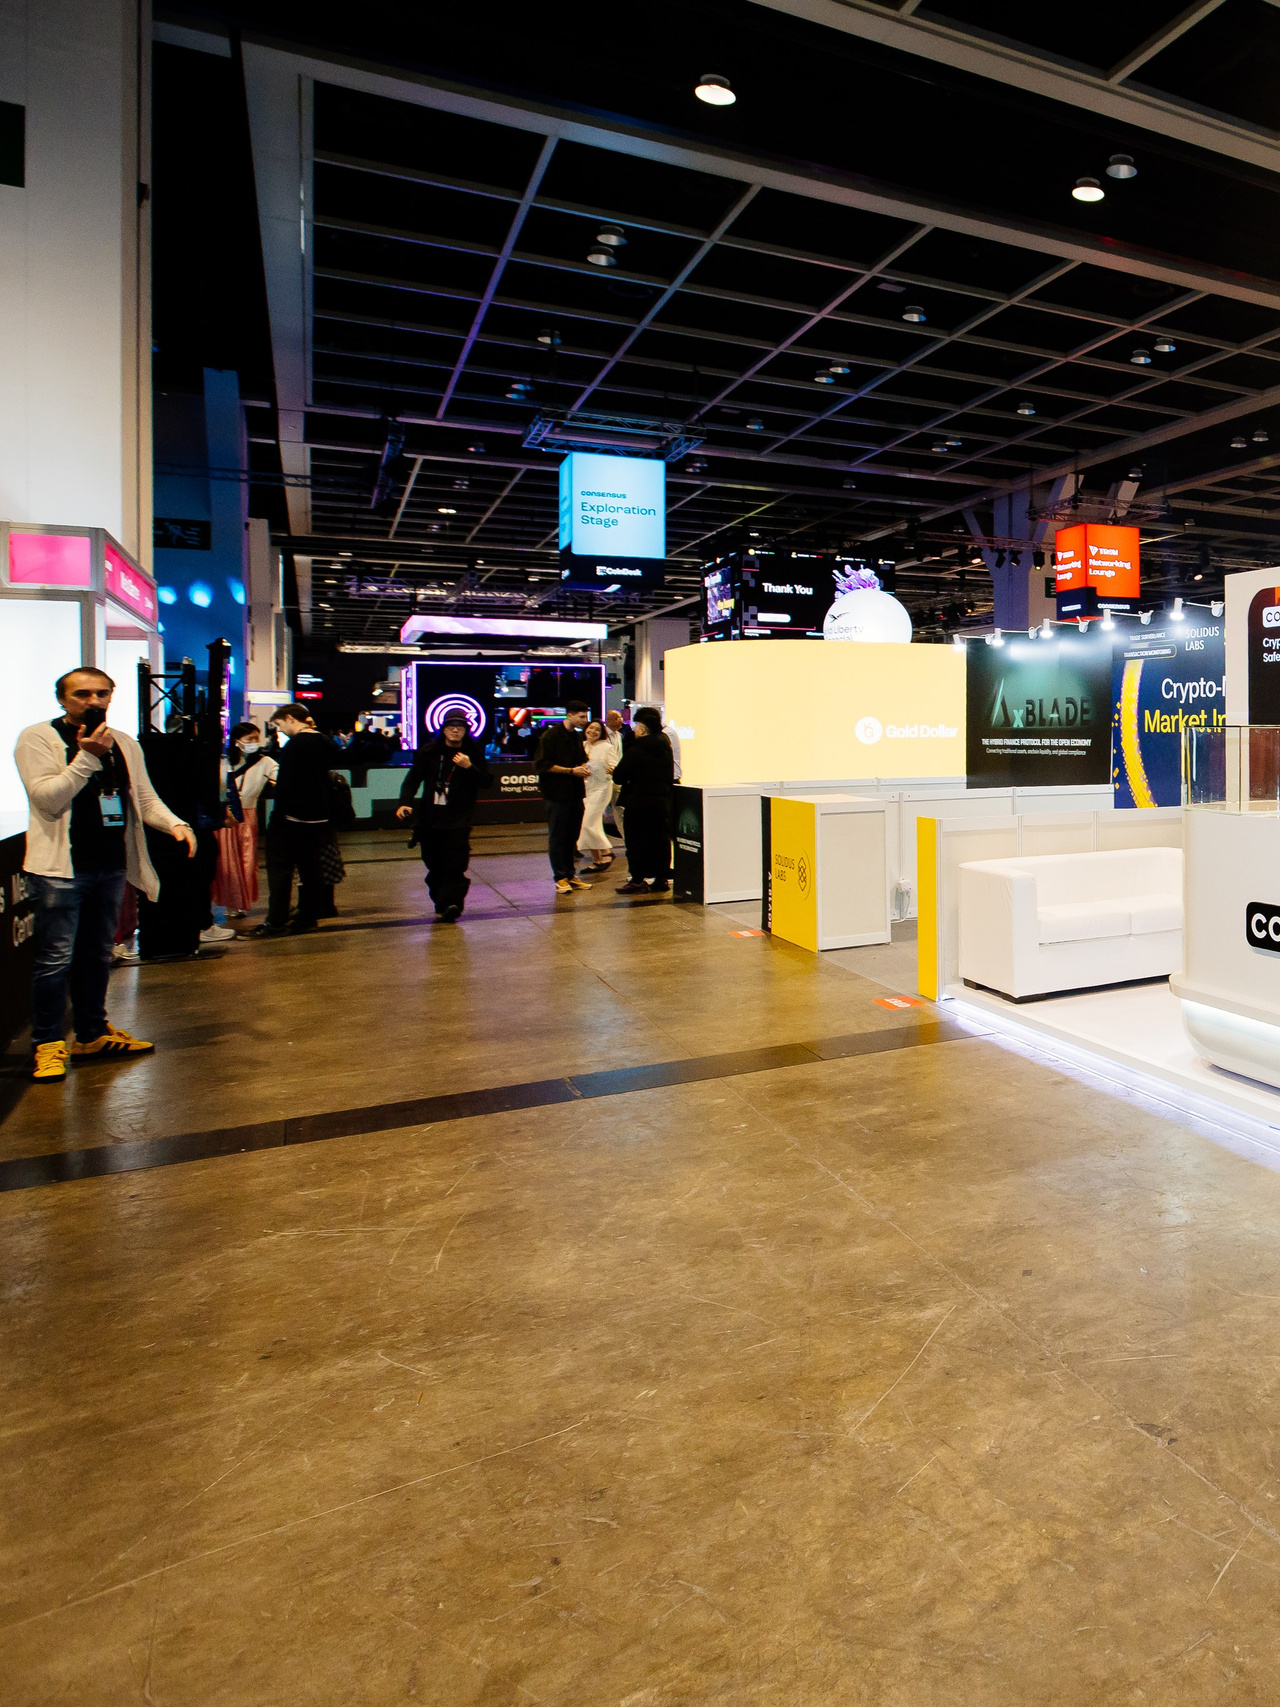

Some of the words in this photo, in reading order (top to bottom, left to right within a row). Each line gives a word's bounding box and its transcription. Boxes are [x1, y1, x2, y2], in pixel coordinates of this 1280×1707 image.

[581, 502, 657, 516] Exploration
[581, 515, 619, 528] Stage
[1089, 559, 1132, 570] Networking
[1089, 568, 1116, 578] Lounge
[762, 583, 793, 594] Thank
[794, 584, 813, 595] You
[1185, 626, 1219, 638] SOLIDUS
[1185, 640, 1204, 651] LABS
[1144, 708, 1207, 733] Market
[885, 724, 918, 738] Gold
[920, 724, 959, 738] Dollar
[500, 775, 540, 785] cons
[775, 854, 795, 870] SOLIDUS
[775, 868, 786, 881] LABS
